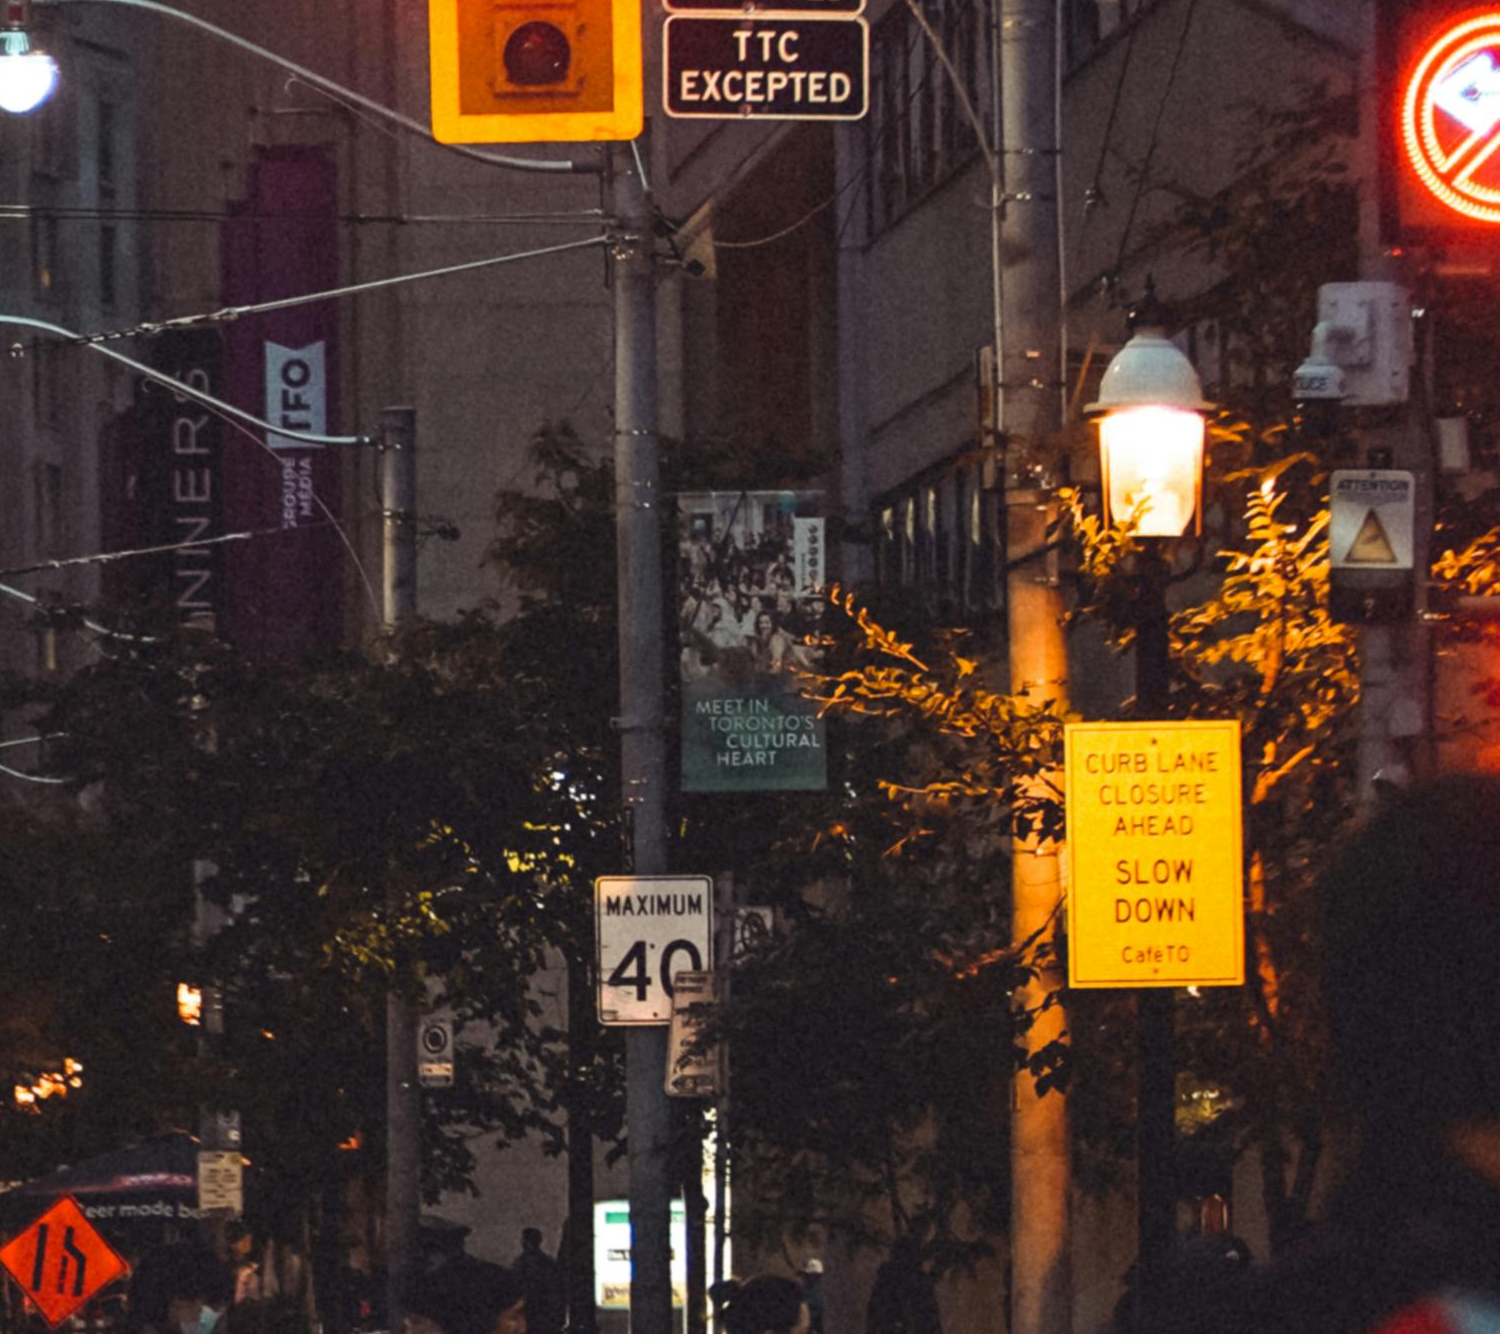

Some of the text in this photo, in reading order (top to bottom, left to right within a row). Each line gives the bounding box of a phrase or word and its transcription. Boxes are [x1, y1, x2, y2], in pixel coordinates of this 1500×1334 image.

[732, 30, 799, 62] TTC
[680, 70, 851, 103] EXCEPTED
[1336, 479, 1410, 493] ATTENTION
[696, 698, 769, 715] MEET IN
[708, 714, 815, 732] TORONTO'S
[726, 733, 820, 749] CULTURAL
[716, 750, 777, 766] HEART
[1085, 751, 1218, 774] CURB LANE
[1099, 783, 1206, 805] CLOSURE
[1114, 815, 1195, 836] AHEAD
[1116, 859, 1194, 885] SLOW
[606, 894, 703, 916] MAXIMUM
[1115, 898, 1196, 924] DOWN
[608, 938, 704, 1002] 40
[77, 1203, 116, 1218] eer
[119, 1200, 173, 1217] made
